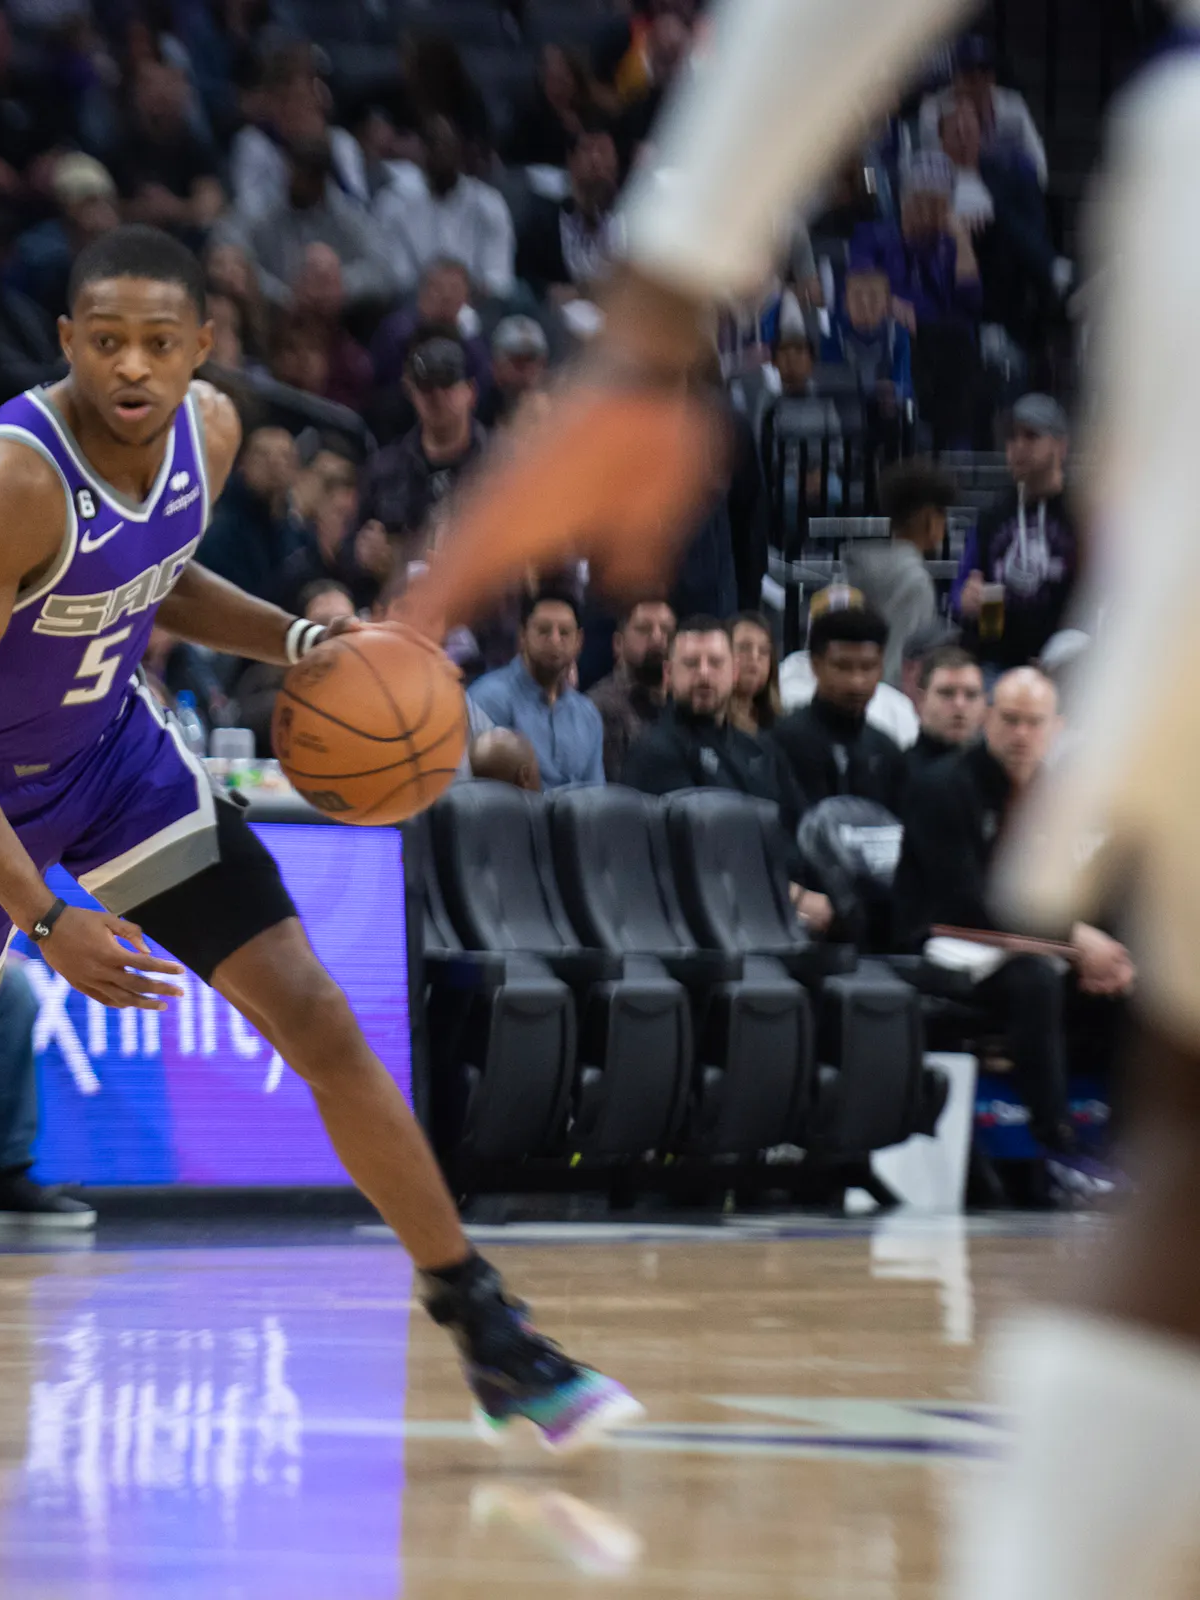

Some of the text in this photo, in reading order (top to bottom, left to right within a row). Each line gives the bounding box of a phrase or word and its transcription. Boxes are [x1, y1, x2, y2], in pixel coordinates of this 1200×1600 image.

[77, 489, 96, 518] 6
[32, 535, 200, 637] SAC
[60, 624, 134, 707] 5
